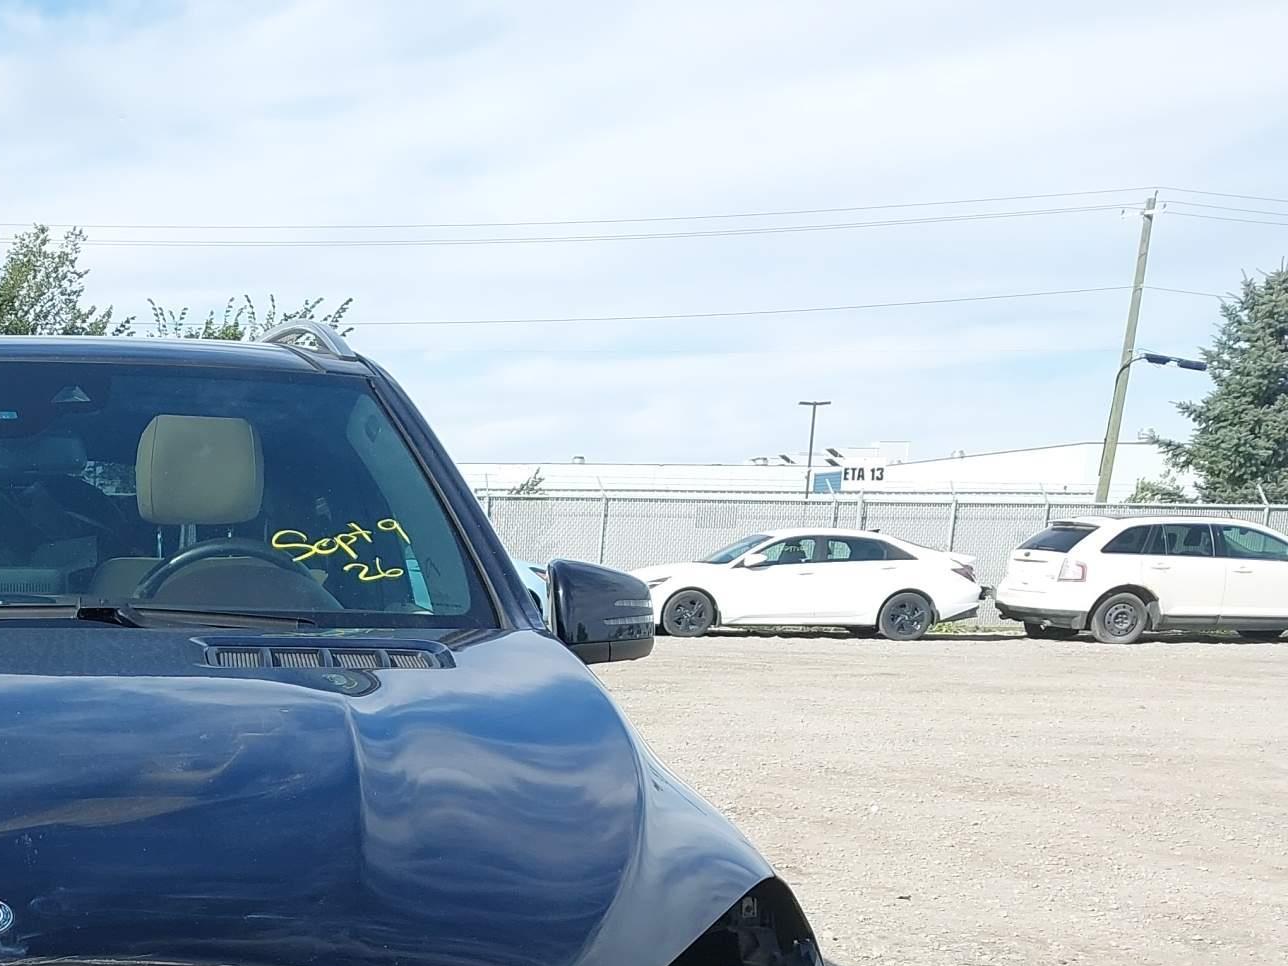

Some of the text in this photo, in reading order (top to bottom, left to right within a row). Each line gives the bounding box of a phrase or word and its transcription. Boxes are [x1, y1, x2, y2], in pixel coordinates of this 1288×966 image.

[843, 467, 884, 481] ETA 13
[377, 518, 411, 545] 9
[343, 556, 404, 581] 26
